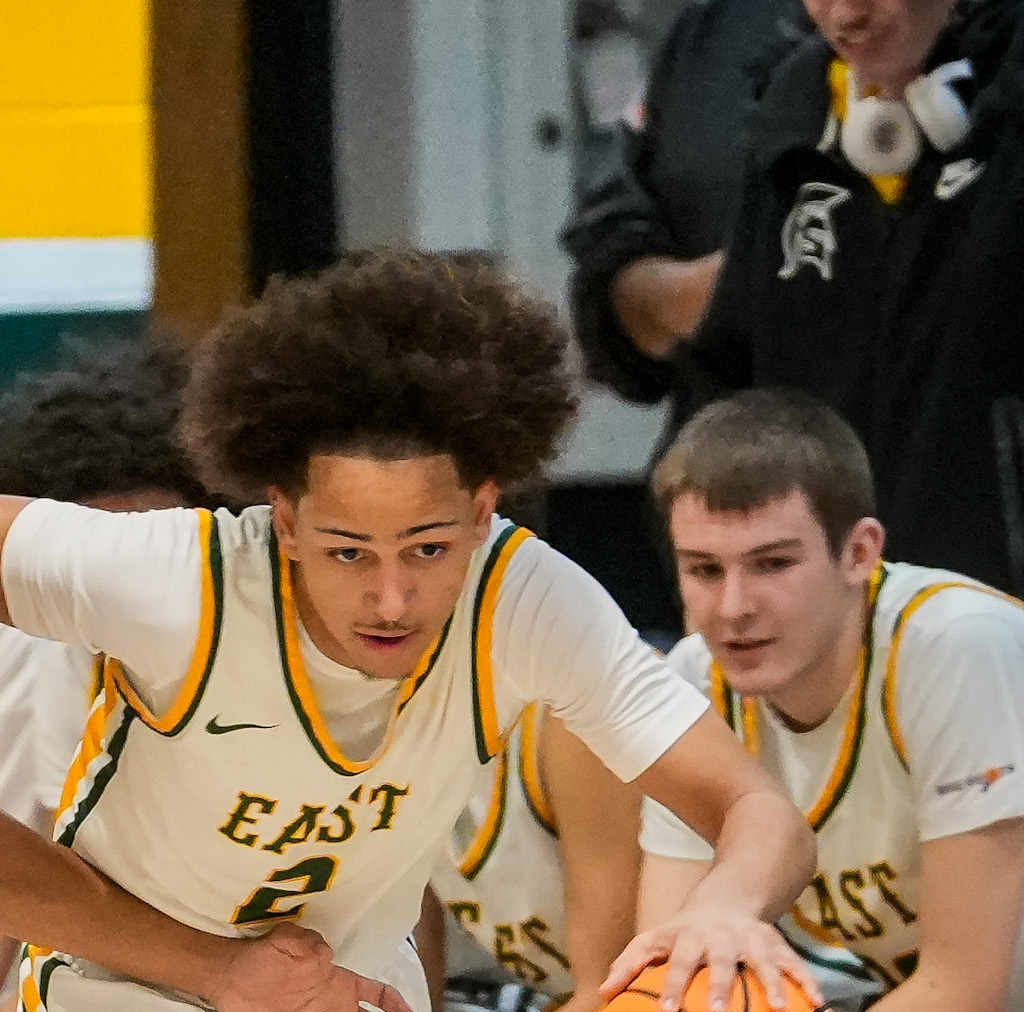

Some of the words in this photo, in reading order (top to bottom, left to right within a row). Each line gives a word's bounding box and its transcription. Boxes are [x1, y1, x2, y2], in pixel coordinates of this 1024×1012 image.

[217, 783, 411, 855] EAST
[229, 854, 341, 927] 2
[810, 860, 918, 942] AST
